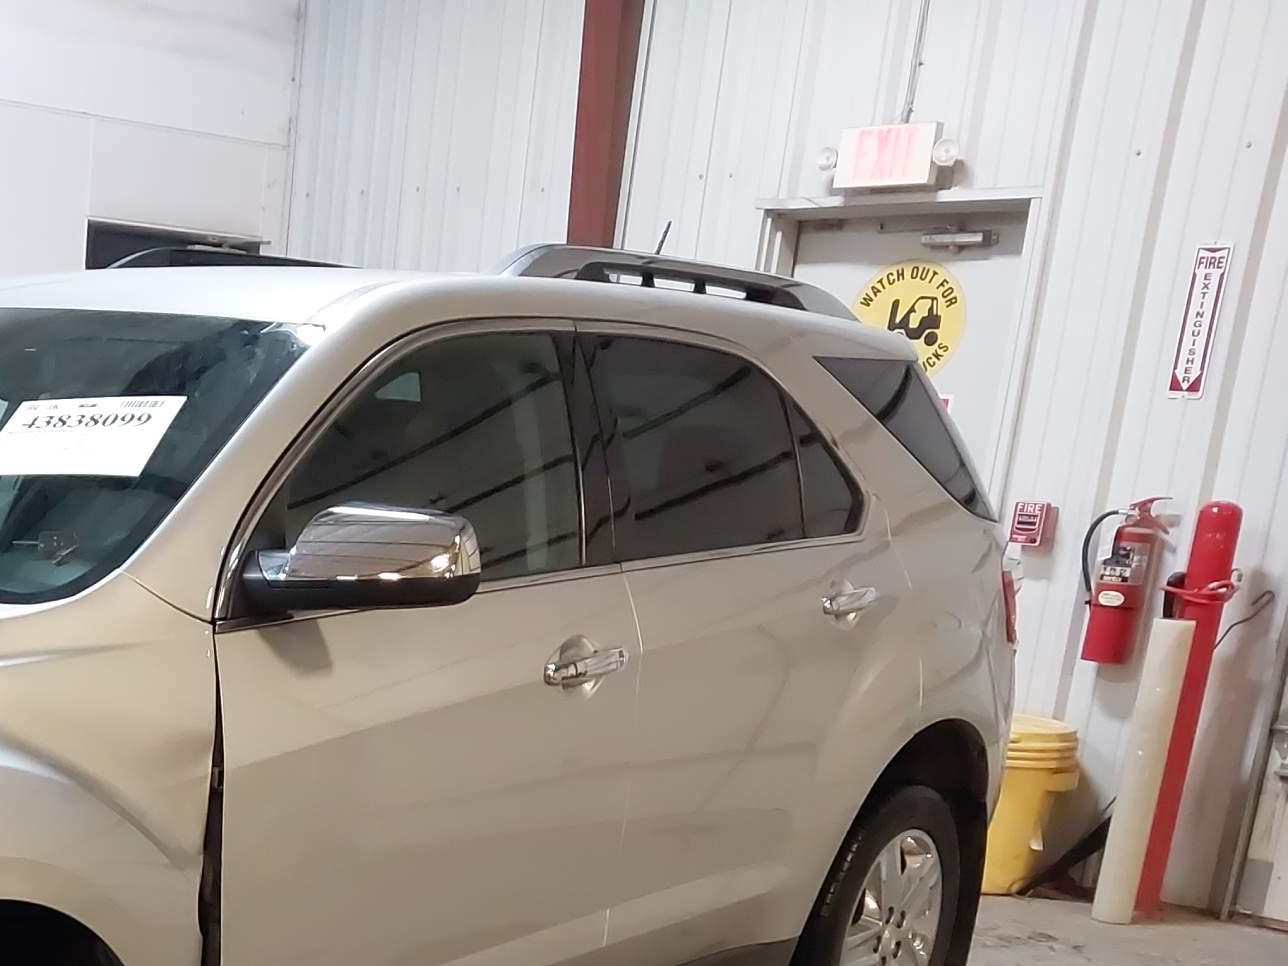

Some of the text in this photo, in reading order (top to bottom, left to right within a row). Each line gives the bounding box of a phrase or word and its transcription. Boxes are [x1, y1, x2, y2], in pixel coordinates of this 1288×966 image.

[854, 127, 919, 177] EXIT
[1197, 255, 1226, 270] FIRE
[860, 265, 958, 308] WATCH OUT FOR
[1182, 272, 1213, 384] EXTINGUISHER
[22, 412, 153, 429] 43838099
[1017, 502, 1043, 513] FIRE
